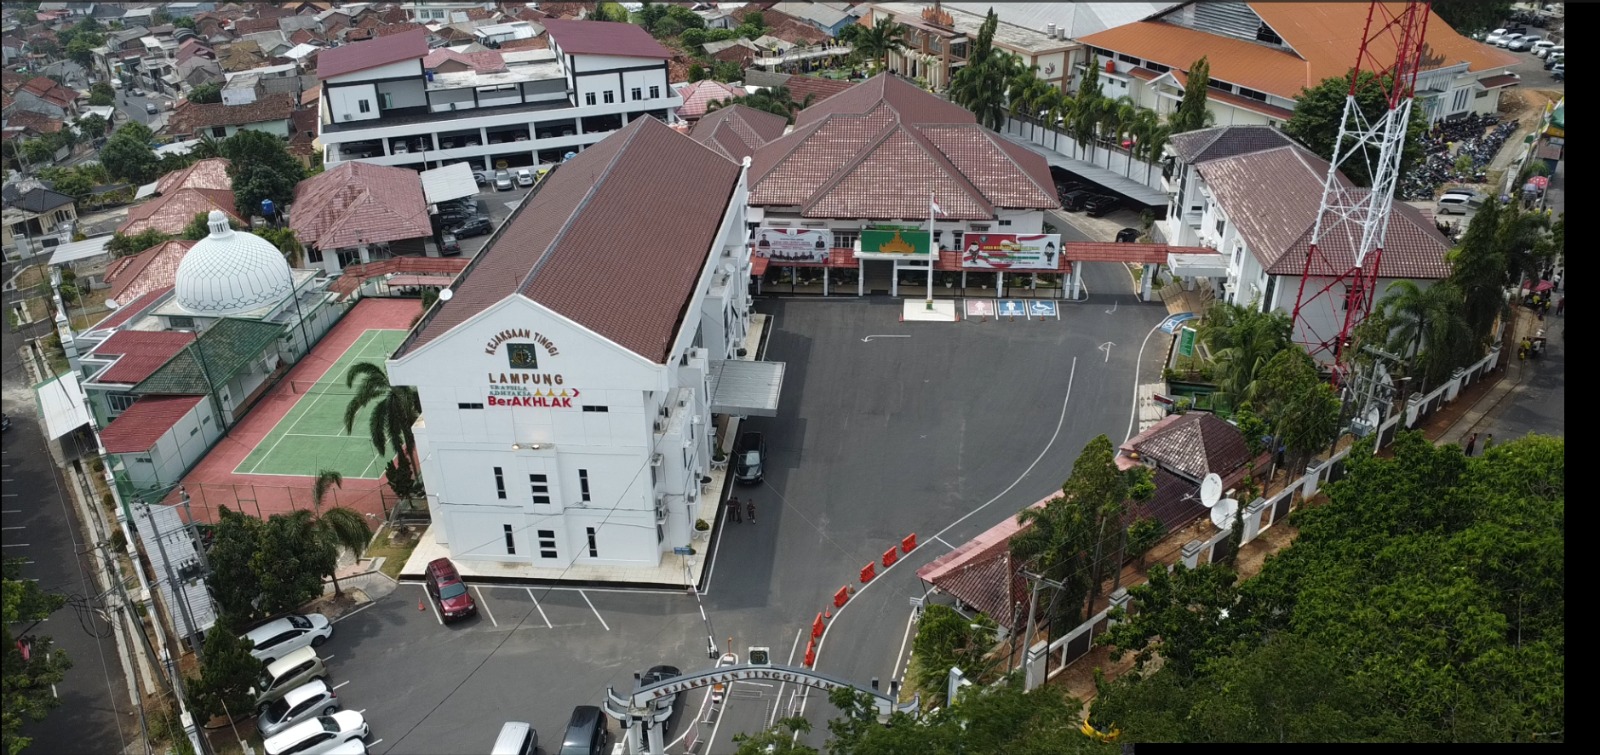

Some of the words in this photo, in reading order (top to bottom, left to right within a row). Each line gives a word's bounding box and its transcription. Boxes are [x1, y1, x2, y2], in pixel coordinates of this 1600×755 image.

[485, 328, 530, 355] KEJAKSAAN
[533, 332, 559, 357] TINGGI
[488, 373, 563, 385] LAMPUNG
[487, 396, 572, 407] BerAKHLAK
[652, 671, 740, 698] KEJAKSAAN
[744, 671, 798, 682] TINGGI
